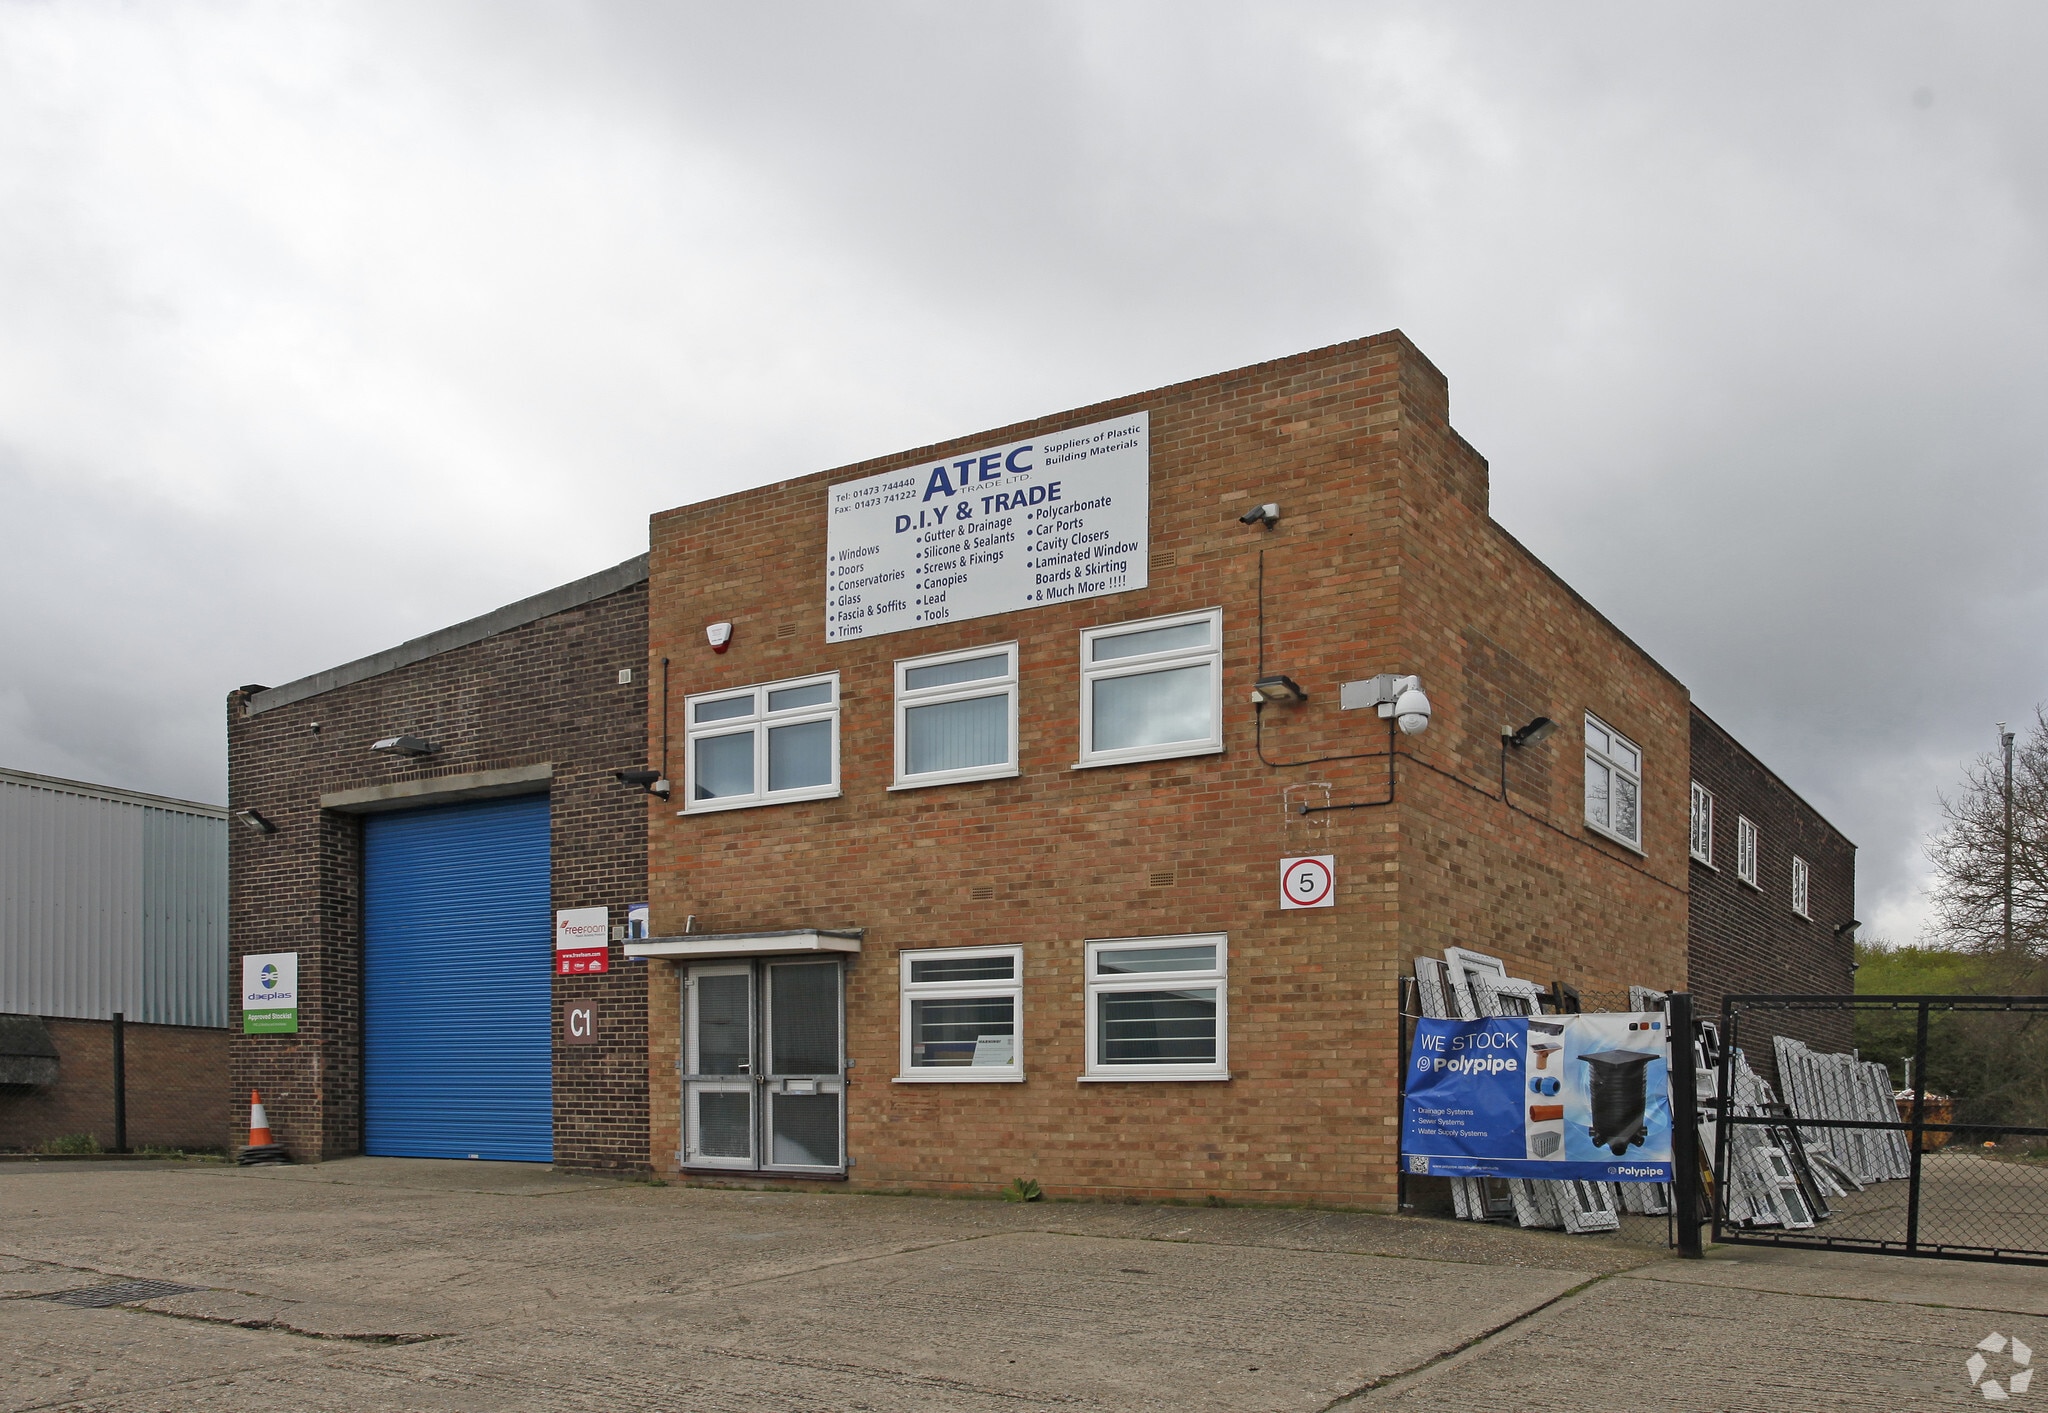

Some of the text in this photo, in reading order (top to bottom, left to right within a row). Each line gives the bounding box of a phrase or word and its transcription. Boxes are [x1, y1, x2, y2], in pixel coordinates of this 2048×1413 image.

[1044, 425, 1141, 453] Suppliers of Plastic
[1046, 439, 1138, 466] Building Materials
[922, 445, 1034, 502] ATEC
[960, 473, 1032, 494] TRADE LTD.
[836, 477, 915, 502] Tel: 01473 744440
[834, 489, 917, 514] Fax: 01473 741222
[895, 481, 1061, 534] D.I.Y & TRADE
[1036, 496, 1112, 520] Polycarbonate
[924, 517, 1013, 543] Gutter & Drainage
[1036, 518, 1084, 536] Car Ports
[924, 531, 1015, 558] Silicone & Sealants
[1036, 530, 1109, 552] Cavity Closers
[838, 545, 880, 561] Windows
[924, 550, 1004, 574] Screws & Fixings
[1036, 541, 1139, 569] Laminated Window
[838, 563, 864, 576] Doors
[838, 569, 905, 591] Conservatories
[924, 572, 968, 589] Canopies
[1036, 559, 1127, 585] Boards & Skirting
[924, 590, 946, 605] Lead
[1036, 575, 1126, 601] & Much More !!!!
[838, 594, 861, 606] Glass
[838, 599, 907, 621] Fascia & Soffits
[924, 606, 949, 621] Tools
[838, 624, 863, 637] Trims
[1299, 873, 1314, 893] 5
[248, 1013, 271, 1021] Approved
[570, 1008, 591, 1037] C1
[1421, 1032, 1519, 1052] WE STOCK
[1433, 1054, 1518, 1076] Polypipe
[1418, 1107, 1474, 1116] Drainage Systems
[1437, 1118, 1465, 1126] Systems
[1437, 1128, 1459, 1137] Supply
[1459, 1129, 1488, 1138] Systems
[1618, 1166, 1664, 1177] Polypipe
